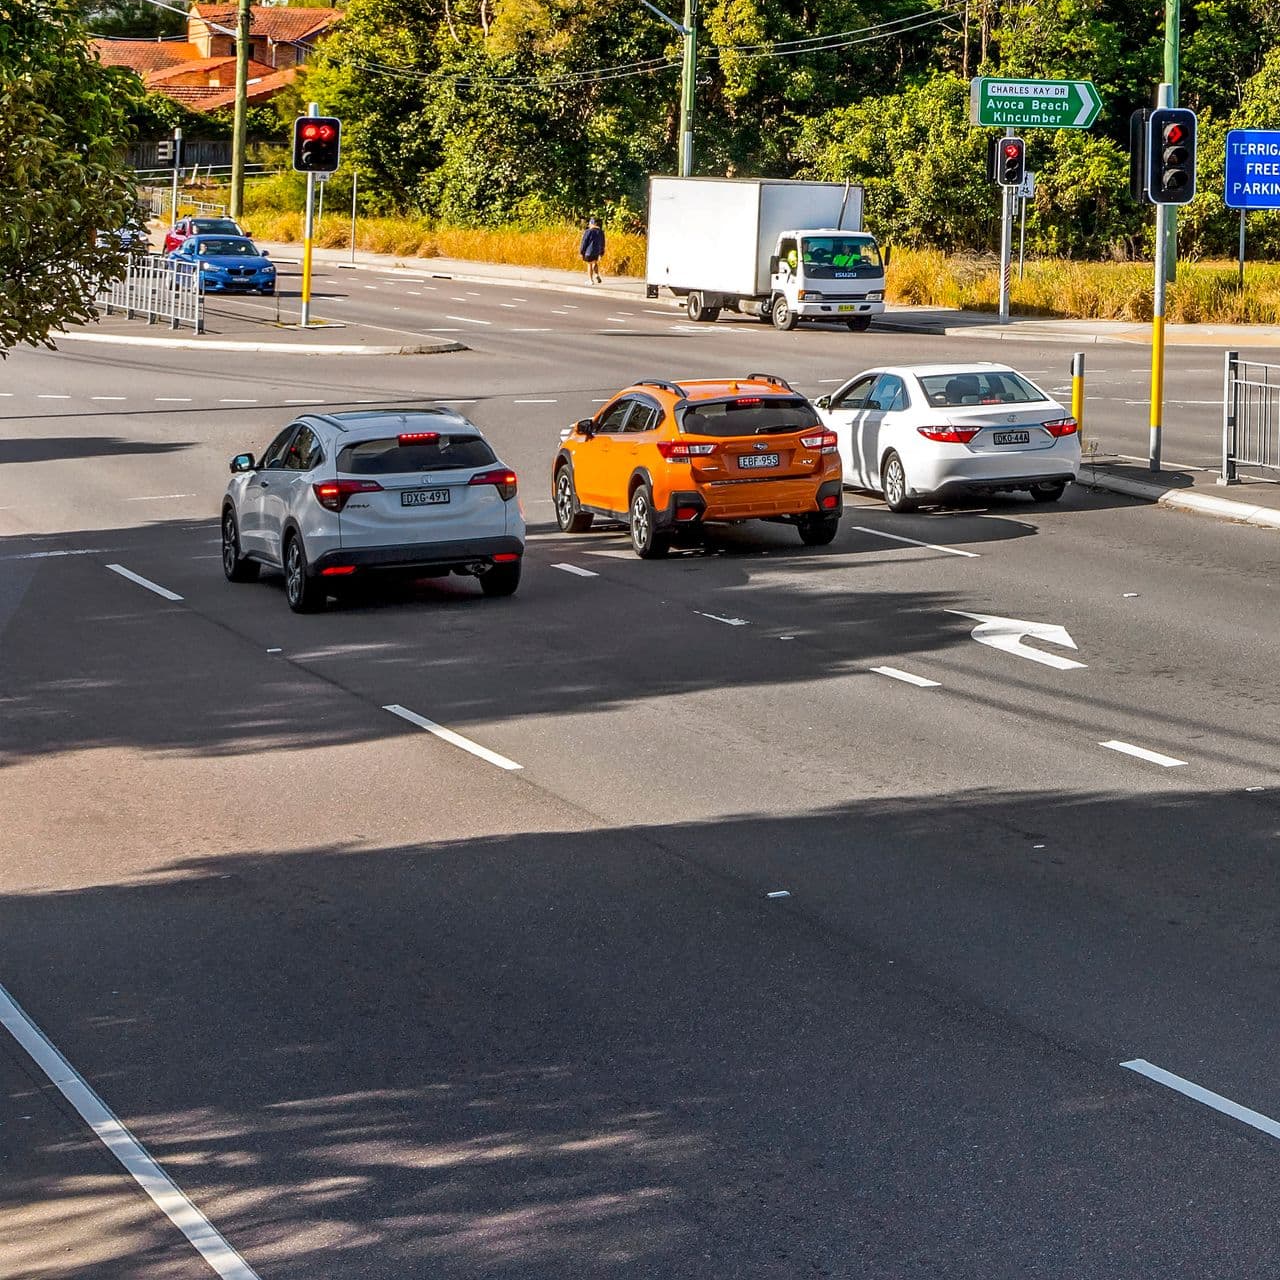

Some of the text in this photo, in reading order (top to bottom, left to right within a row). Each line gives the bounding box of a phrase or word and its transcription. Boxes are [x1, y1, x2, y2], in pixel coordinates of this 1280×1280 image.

[991, 85, 1065, 96] CHARLES KAY DR
[987, 99, 1069, 111] Avoca Beach
[993, 111, 1062, 123] Kincumber
[1246, 163, 1280, 175] FREE
